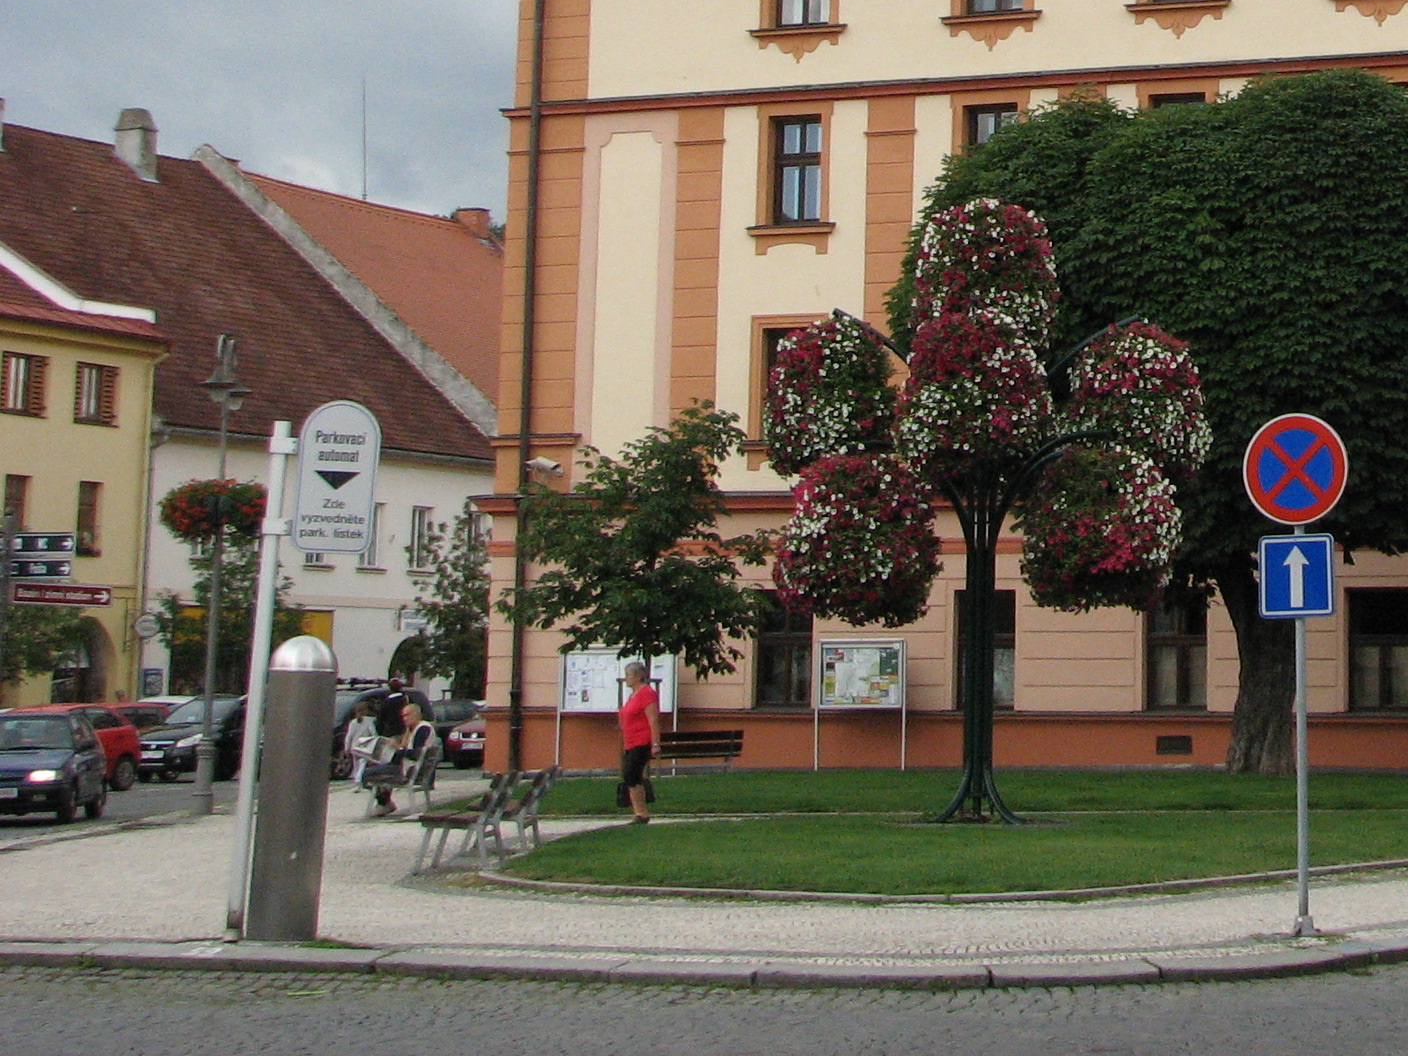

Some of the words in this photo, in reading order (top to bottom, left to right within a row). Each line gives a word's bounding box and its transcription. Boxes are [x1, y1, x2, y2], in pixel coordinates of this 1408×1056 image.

[315, 430, 367, 445] Parkovací
[318, 449, 359, 462] automat
[322, 498, 346, 509] Zde
[301, 513, 365, 525] vyzvedněte
